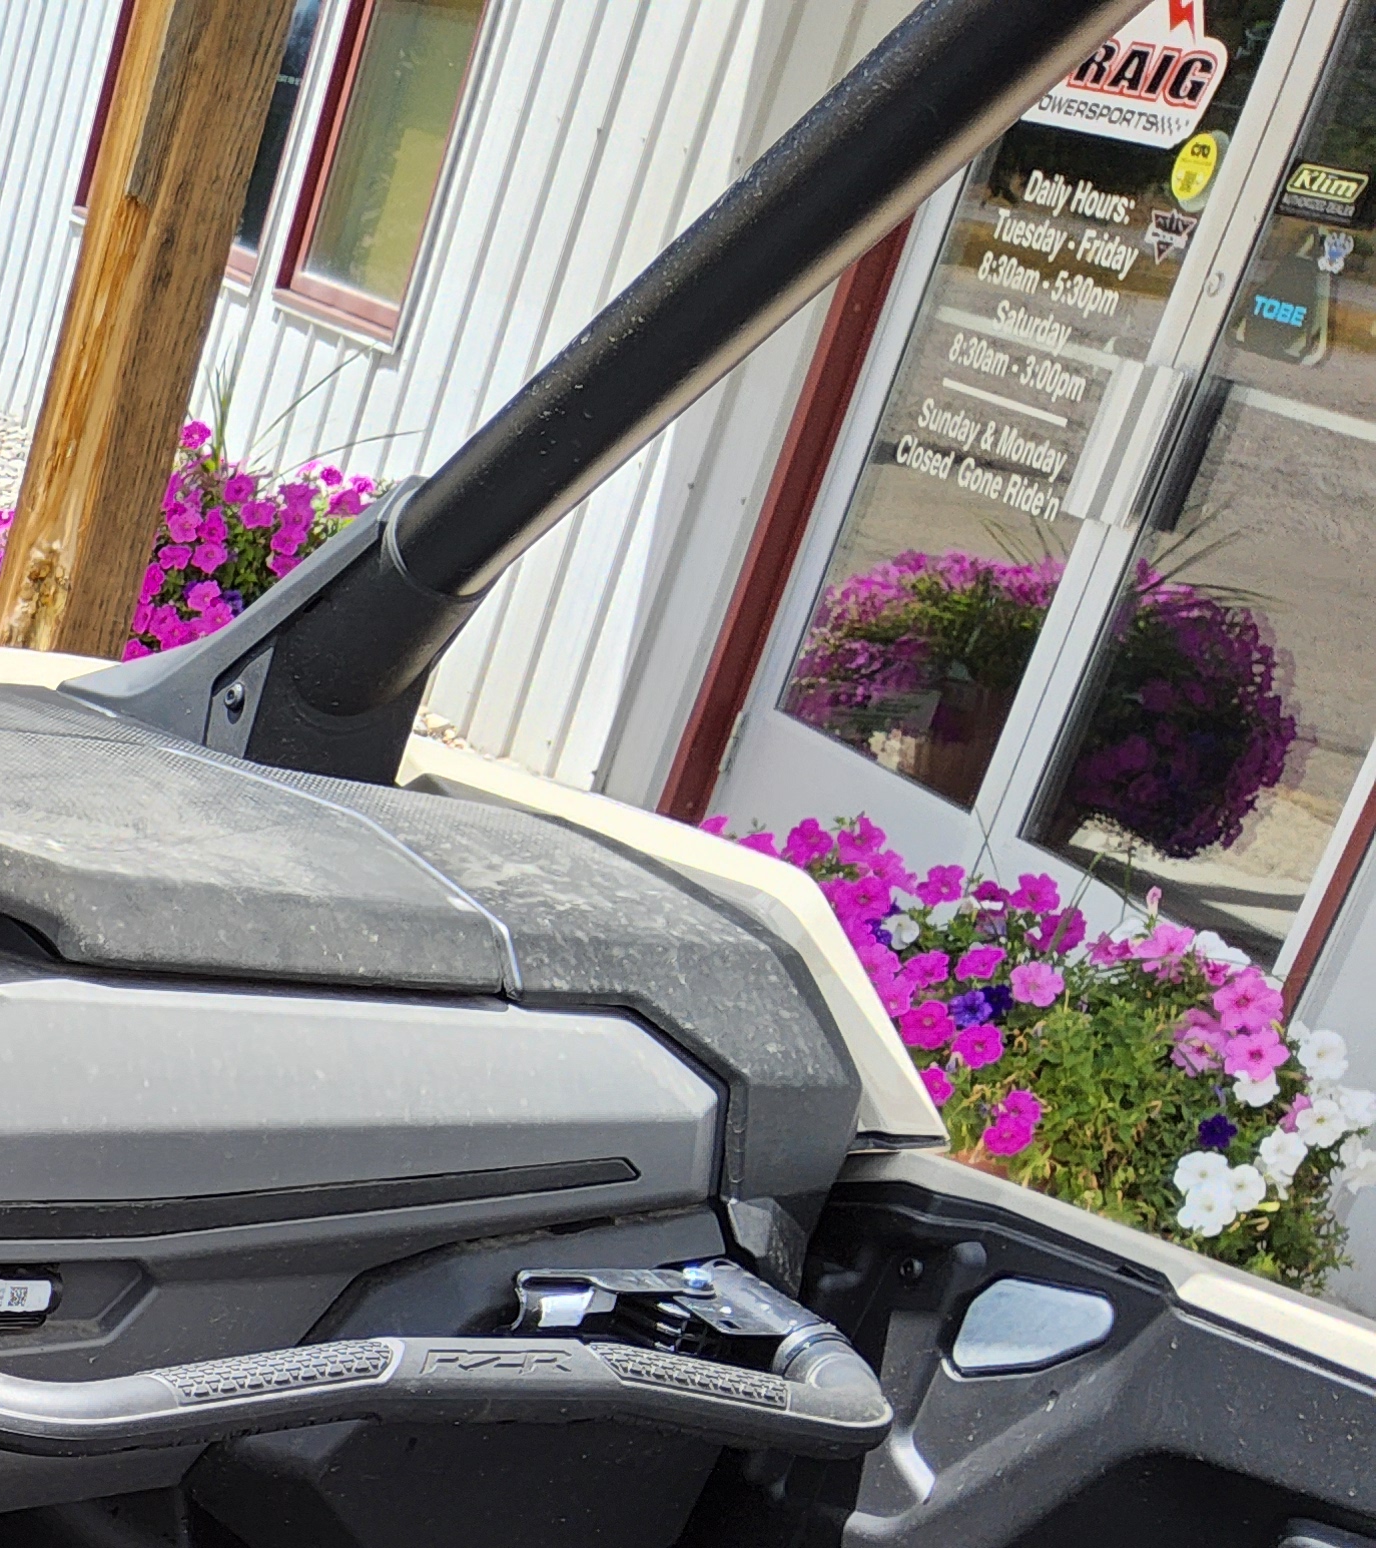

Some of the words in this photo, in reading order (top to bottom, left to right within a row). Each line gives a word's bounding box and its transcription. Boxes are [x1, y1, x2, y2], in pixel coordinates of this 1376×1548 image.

[1066, 38, 1218, 109] RAIG
[1038, 93, 1159, 132] OWERSPORTS
[1023, 169, 1072, 217] Daily
[1070, 179, 1136, 225] Hours:
[1294, 169, 1358, 198] Klim
[993, 208, 1068, 263] Tuesday
[1076, 228, 1139, 281] Friday
[977, 250, 1041, 295] 8:30am
[1050, 270, 1120, 319] 5:30pm
[1254, 294, 1307, 327] TOBE
[992, 299, 1073, 357] Saturday
[948, 332, 1010, 378] 8:30am
[1019, 354, 1087, 403] 3:00pm
[917, 398, 982, 452] Sunday
[980, 420, 996, 452] &
[996, 424, 1068, 483] Monday
[896, 434, 956, 481] Closed
[957, 456, 1003, 500] Gone
[1003, 473, 1061, 522] Ride'n
